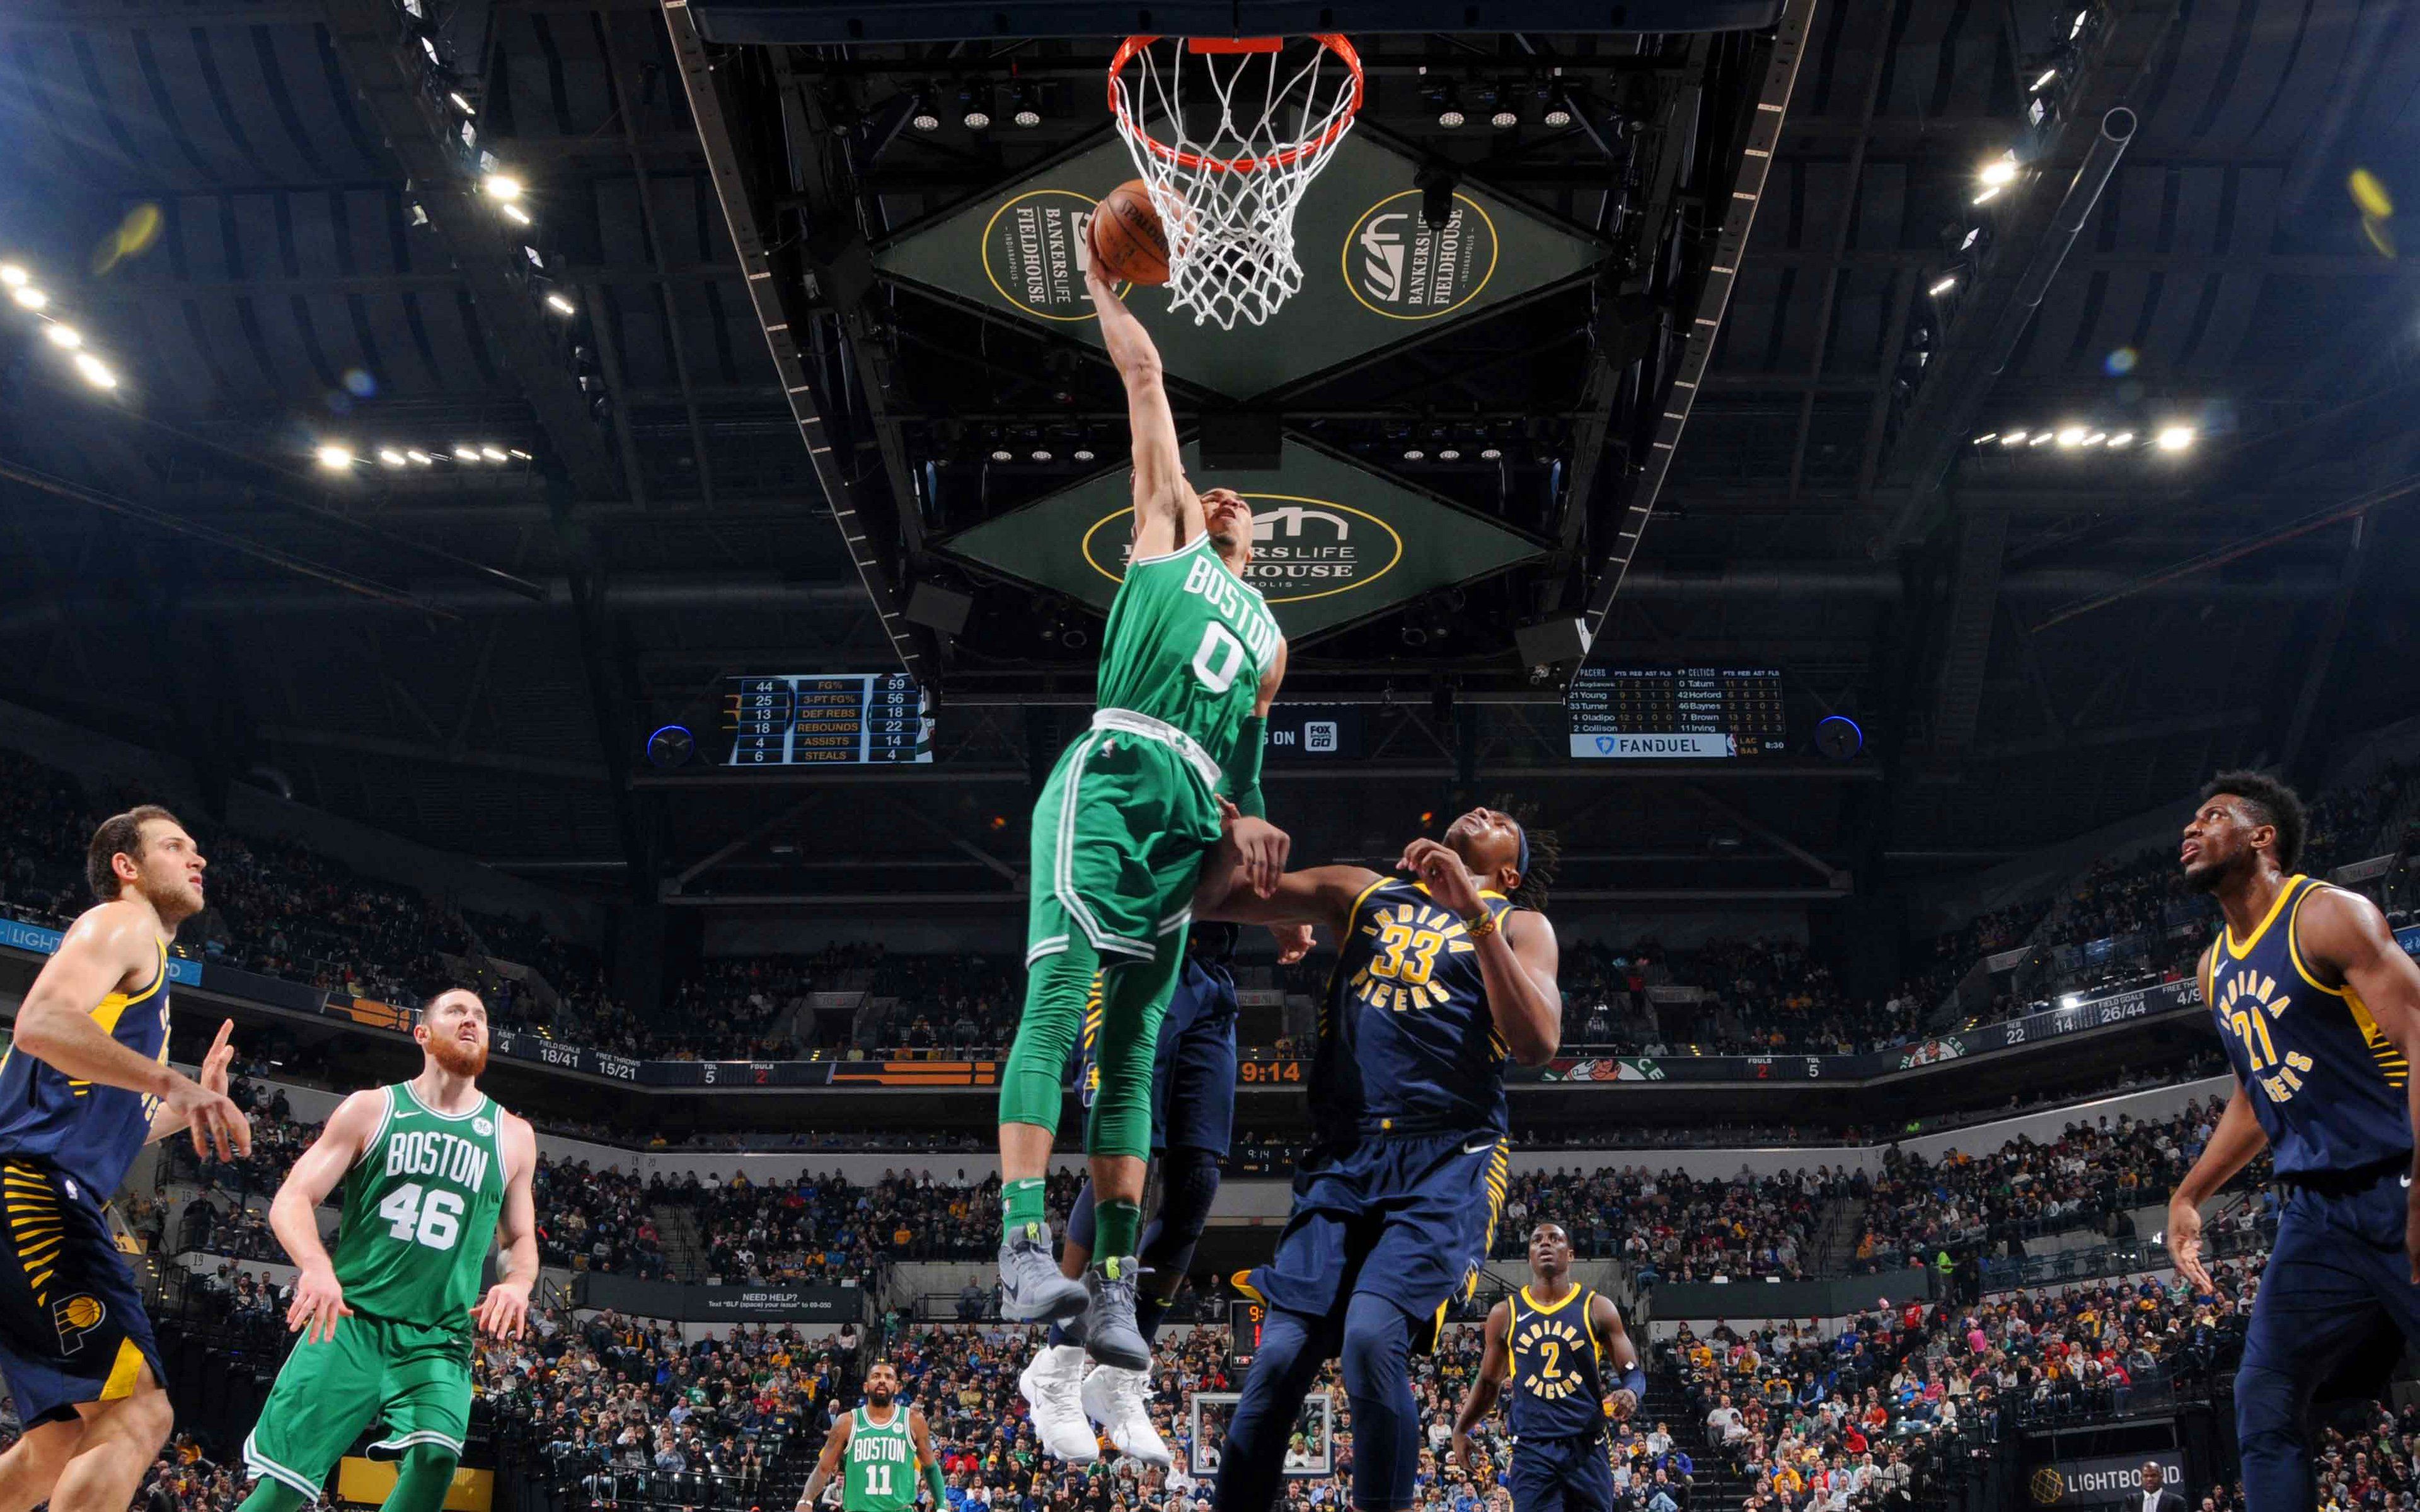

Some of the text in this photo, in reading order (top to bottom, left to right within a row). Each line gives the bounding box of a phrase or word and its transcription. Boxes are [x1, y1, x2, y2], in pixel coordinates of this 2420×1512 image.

[1017, 208, 1046, 302] FIELDHOUSE
[1046, 209, 1071, 302] BANKERS LIFE
[1434, 209, 1463, 304] FIELDHOUSE
[1409, 238, 1430, 304] BANKERS
[1296, 547, 1354, 558] LIFE
[1184, 554, 1276, 672] BOSTON
[1192, 621, 1244, 693] 0
[756, 682, 773, 692] 44
[819, 681, 843, 690] FG%
[888, 679, 905, 689] 59
[756, 696, 772, 706] 25
[887, 694, 904, 704] 56
[756, 709, 771, 719] 13
[802, 709, 855, 718] DEF REBS
[887, 707, 903, 718] 18
[1582, 714, 1615, 722] Oladipo
[754, 723, 770, 733] 18
[798, 723, 858, 731] REBOUNDS
[885, 721, 903, 731] 22
[756, 738, 764, 748] 4
[804, 736, 850, 745] ASSISTS
[885, 736, 901, 746] 14
[1274, 731, 1295, 745] ON
[1311, 738, 1330, 747] GO
[1620, 739, 1701, 752] FANDUEL
[755, 751, 763, 761] 6
[805, 751, 846, 760] STEALS
[887, 750, 896, 760] 4
[1361, 904, 1474, 953] INDIANA
[1369, 924, 1443, 985] 33
[1350, 968, 1450, 1011] PACERS
[2162, 983, 2181, 994] FREE
[2176, 988, 2202, 1005] 4/9
[2101, 1002, 2146, 1023] 26/44
[2056, 1017, 2073, 1033] 14
[2007, 1028, 2025, 1045] 22
[2231, 1006, 2278, 1072] 21
[500, 1040, 509, 1053] 4
[539, 1040, 558, 1050] FIELD
[541, 1048, 579, 1067] 18/41
[596, 1052, 613, 1062] FREE
[599, 1061, 635, 1080] 15/21
[756, 1071, 766, 1083] 2
[1242, 1062, 1301, 1082] 9:14
[1758, 1065, 1768, 1078] 2
[1809, 1065, 1819, 1078] 5
[705, 1071, 715, 1084] 5
[386, 1131, 488, 1193] BOSTON
[379, 1183, 465, 1251] 46
[743, 1293, 797, 1302] NEED HELP?
[1516, 1320, 1585, 1354] INDIANA
[1540, 1342, 1561, 1378] 2
[1524, 1371, 1583, 1399] PACERS
[854, 1437, 906, 1463] BOSTON
[865, 1465, 892, 1495] 11
